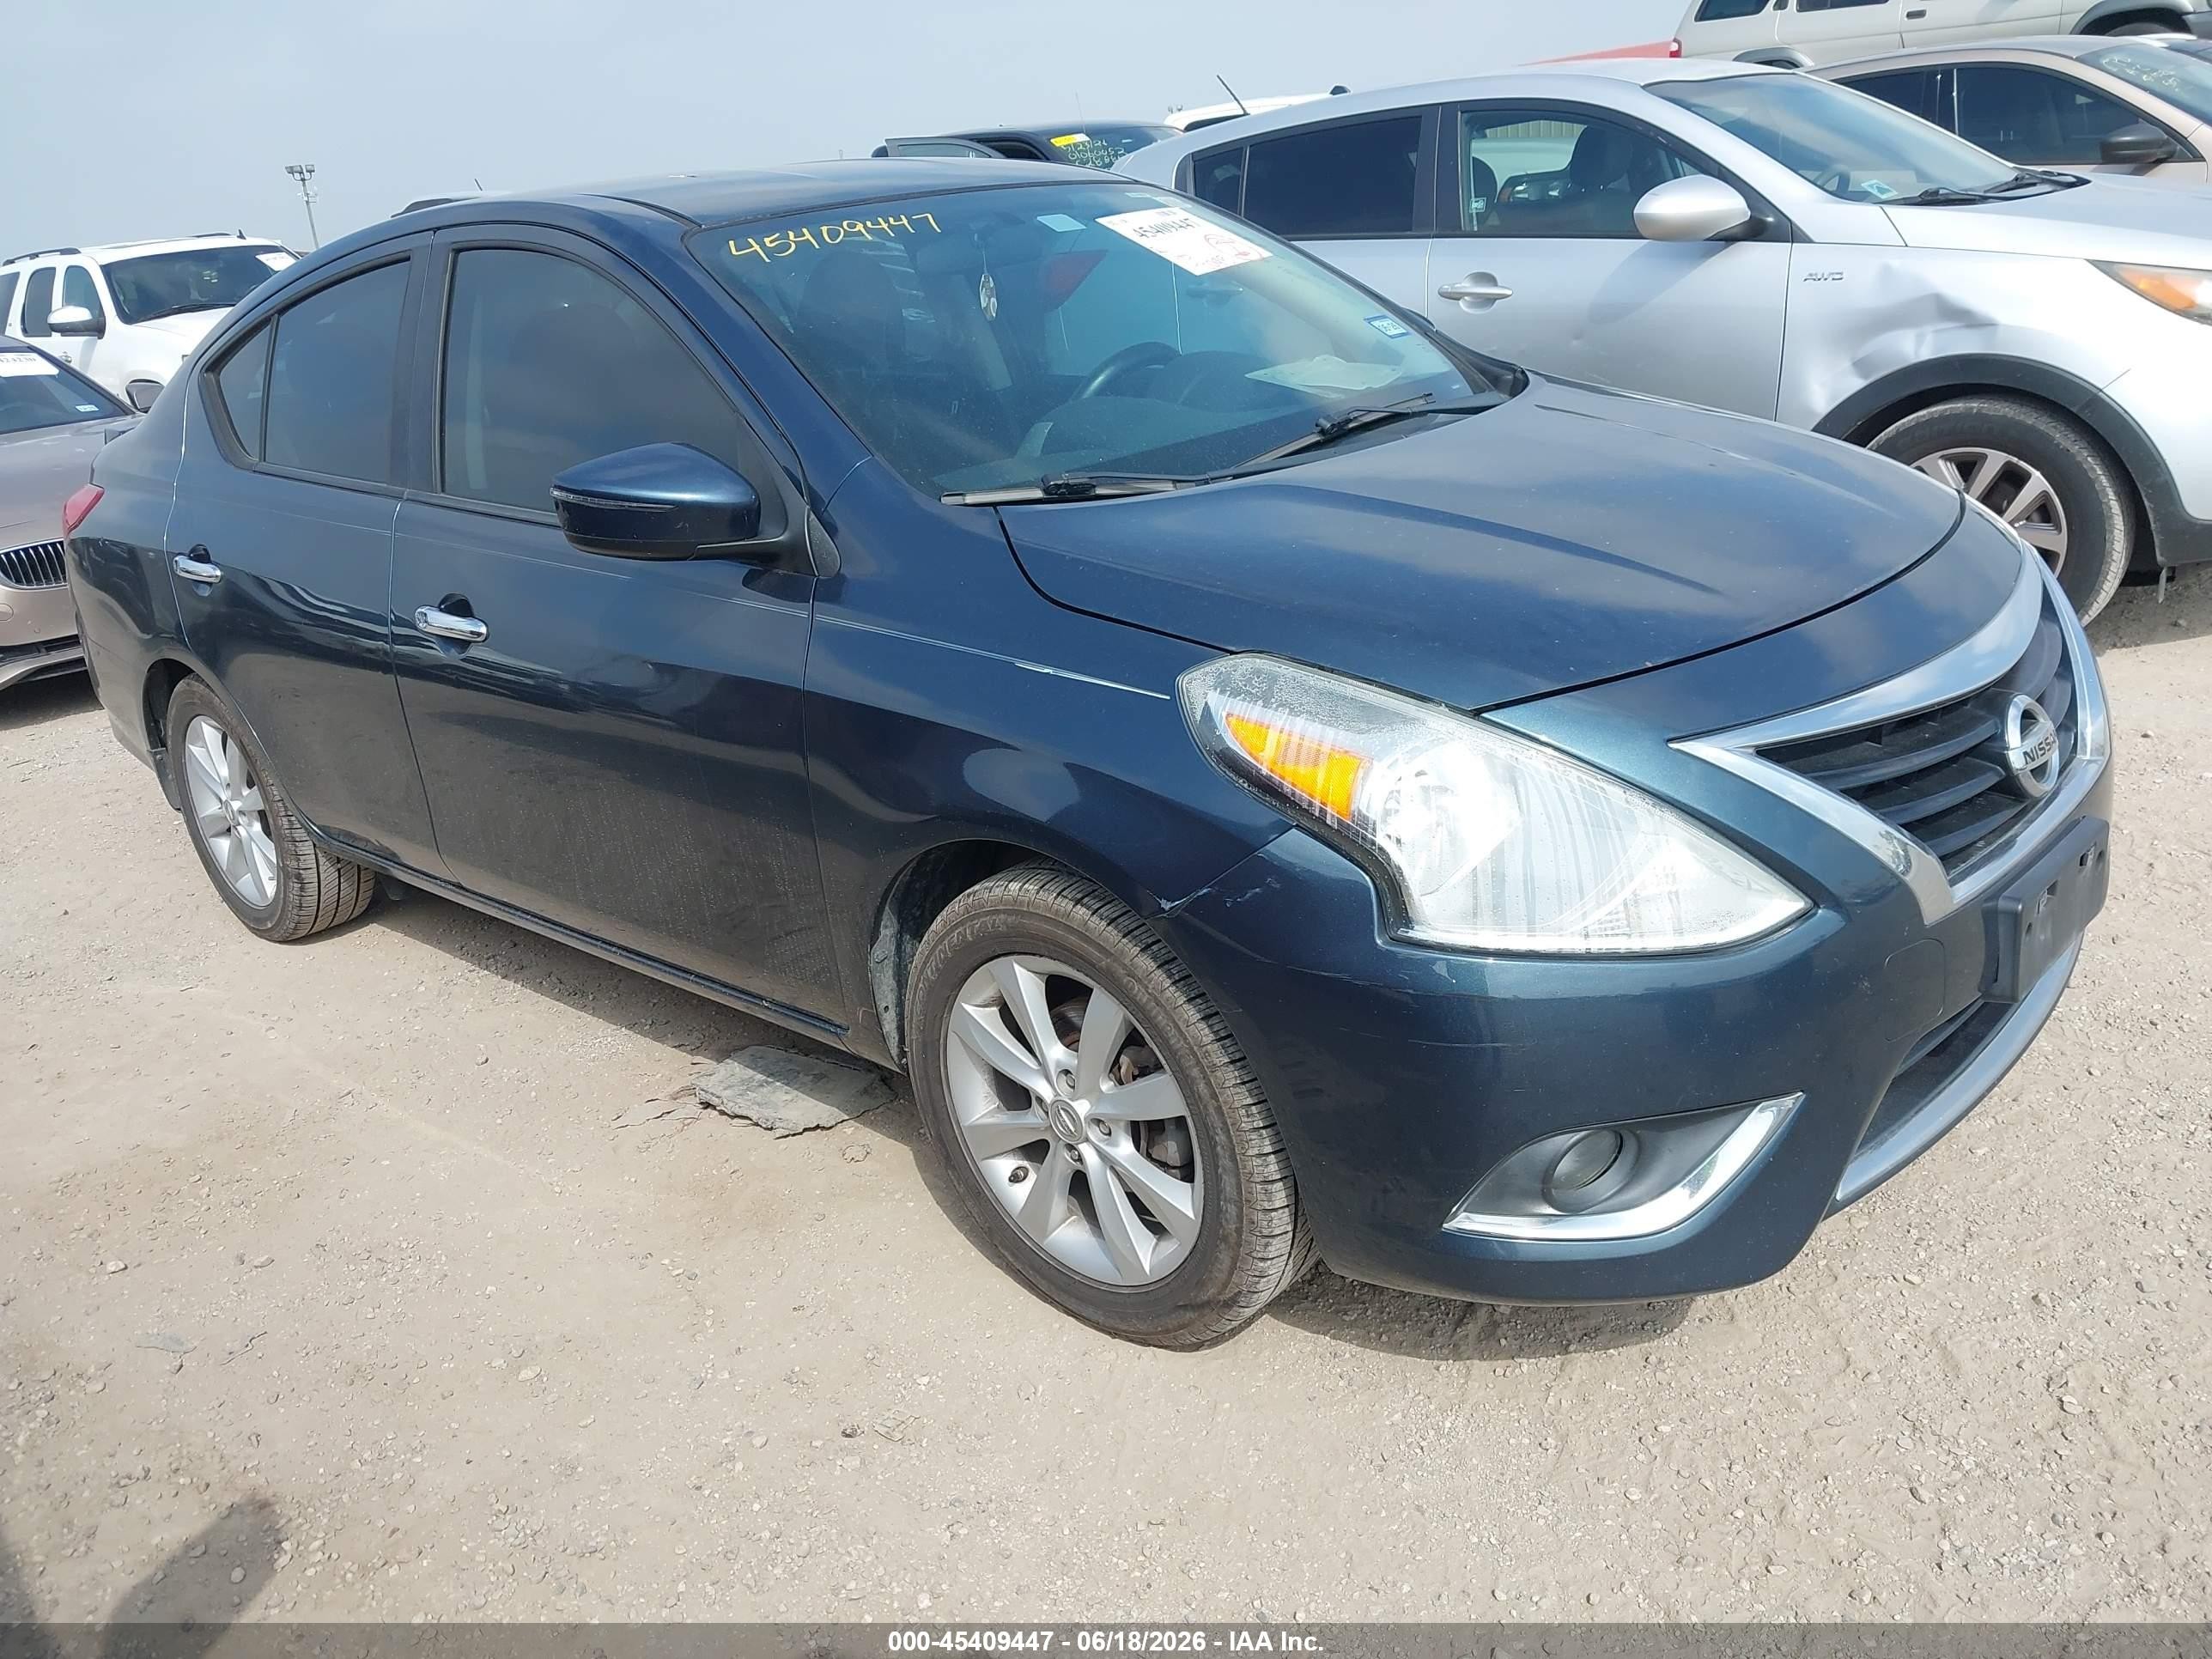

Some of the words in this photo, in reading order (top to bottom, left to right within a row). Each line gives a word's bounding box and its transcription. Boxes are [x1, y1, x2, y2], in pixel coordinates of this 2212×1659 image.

[728, 213, 942, 263] 45409447
[1133, 217, 1200, 239] 45409447
[1802, 271, 1844, 282] AWD
